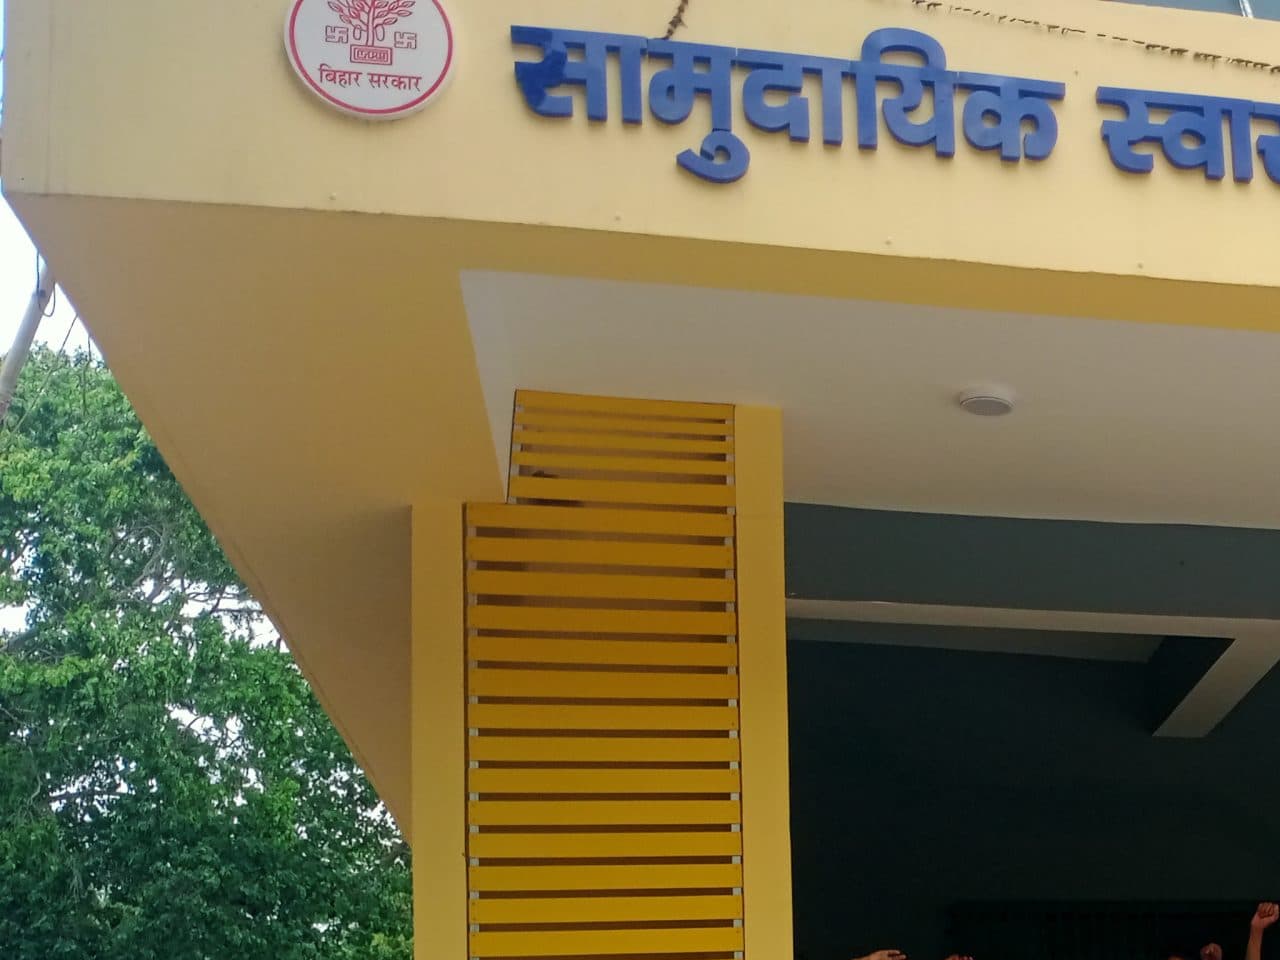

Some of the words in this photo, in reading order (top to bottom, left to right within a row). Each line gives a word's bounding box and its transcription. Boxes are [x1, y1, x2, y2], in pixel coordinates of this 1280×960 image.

[318, 63, 362, 88] बिहार
[367, 71, 422, 92] सरकार
[510, 25, 1066, 184] सामुदायिक
